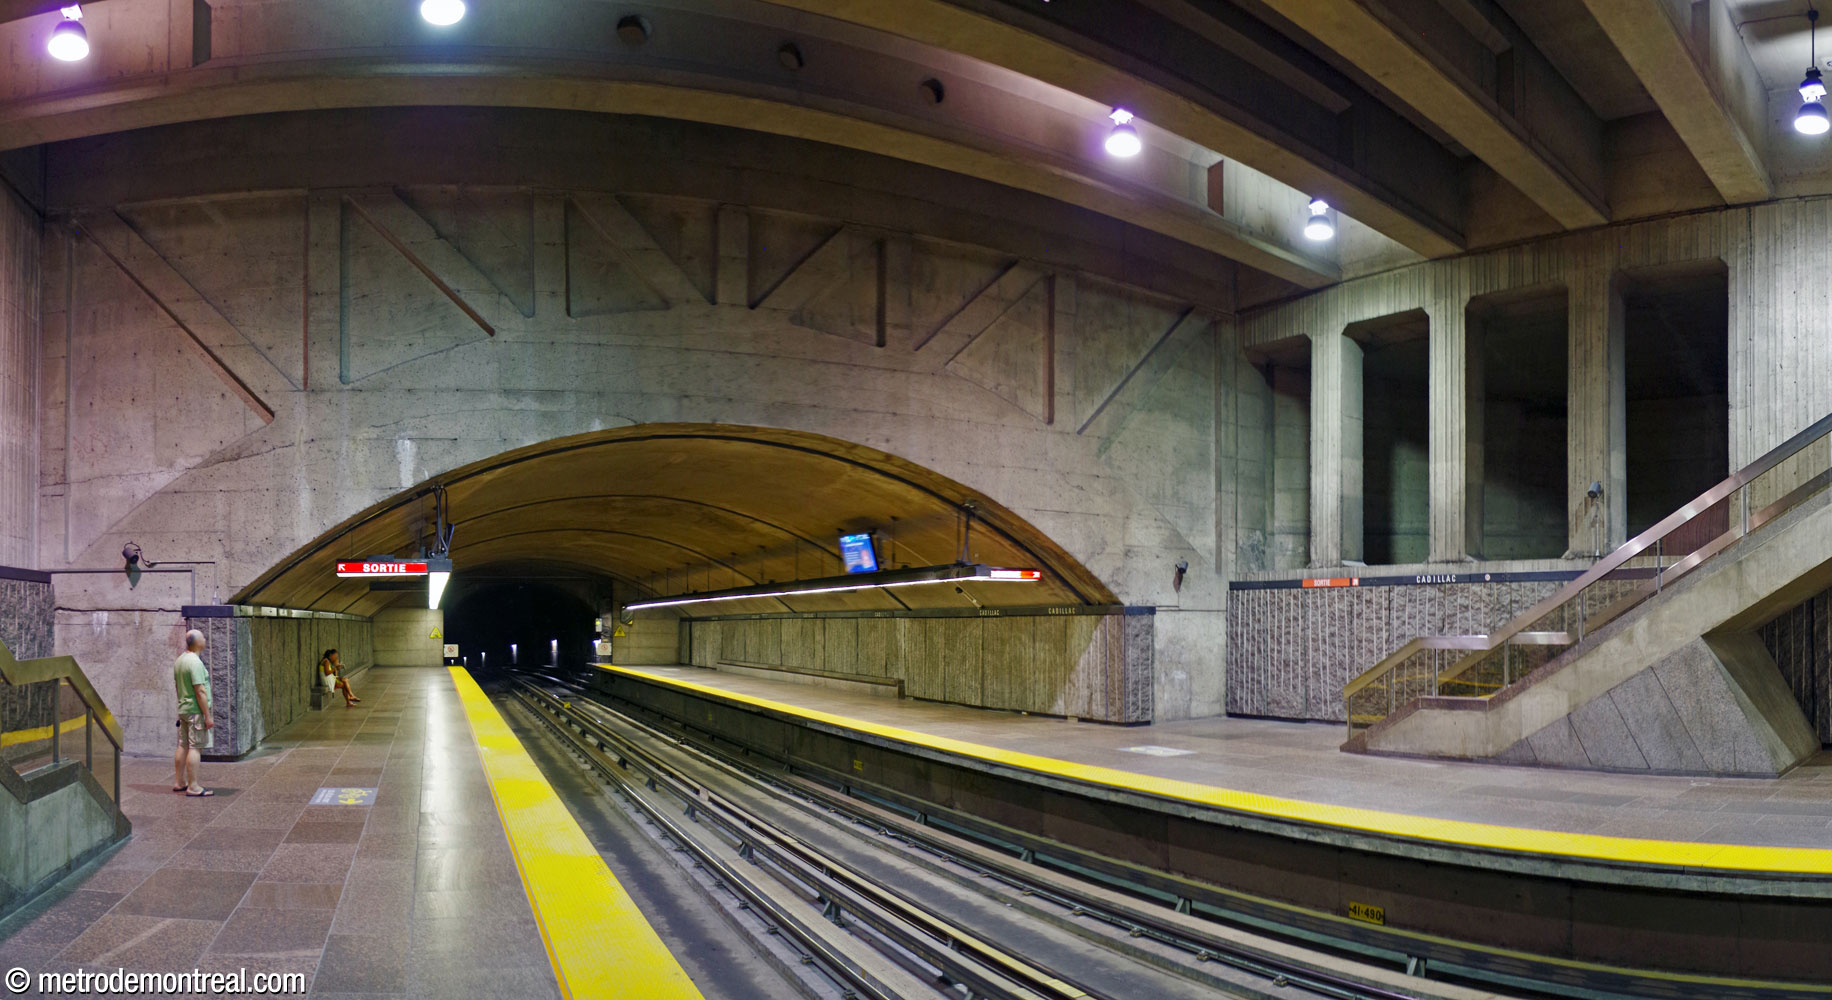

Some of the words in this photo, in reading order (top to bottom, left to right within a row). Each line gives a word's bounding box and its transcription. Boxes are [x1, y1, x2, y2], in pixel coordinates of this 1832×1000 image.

[363, 564, 406, 573] SORTIE
[1416, 574, 1456, 584] CADILLAC
[1048, 607, 1076, 615] CADILLAC
